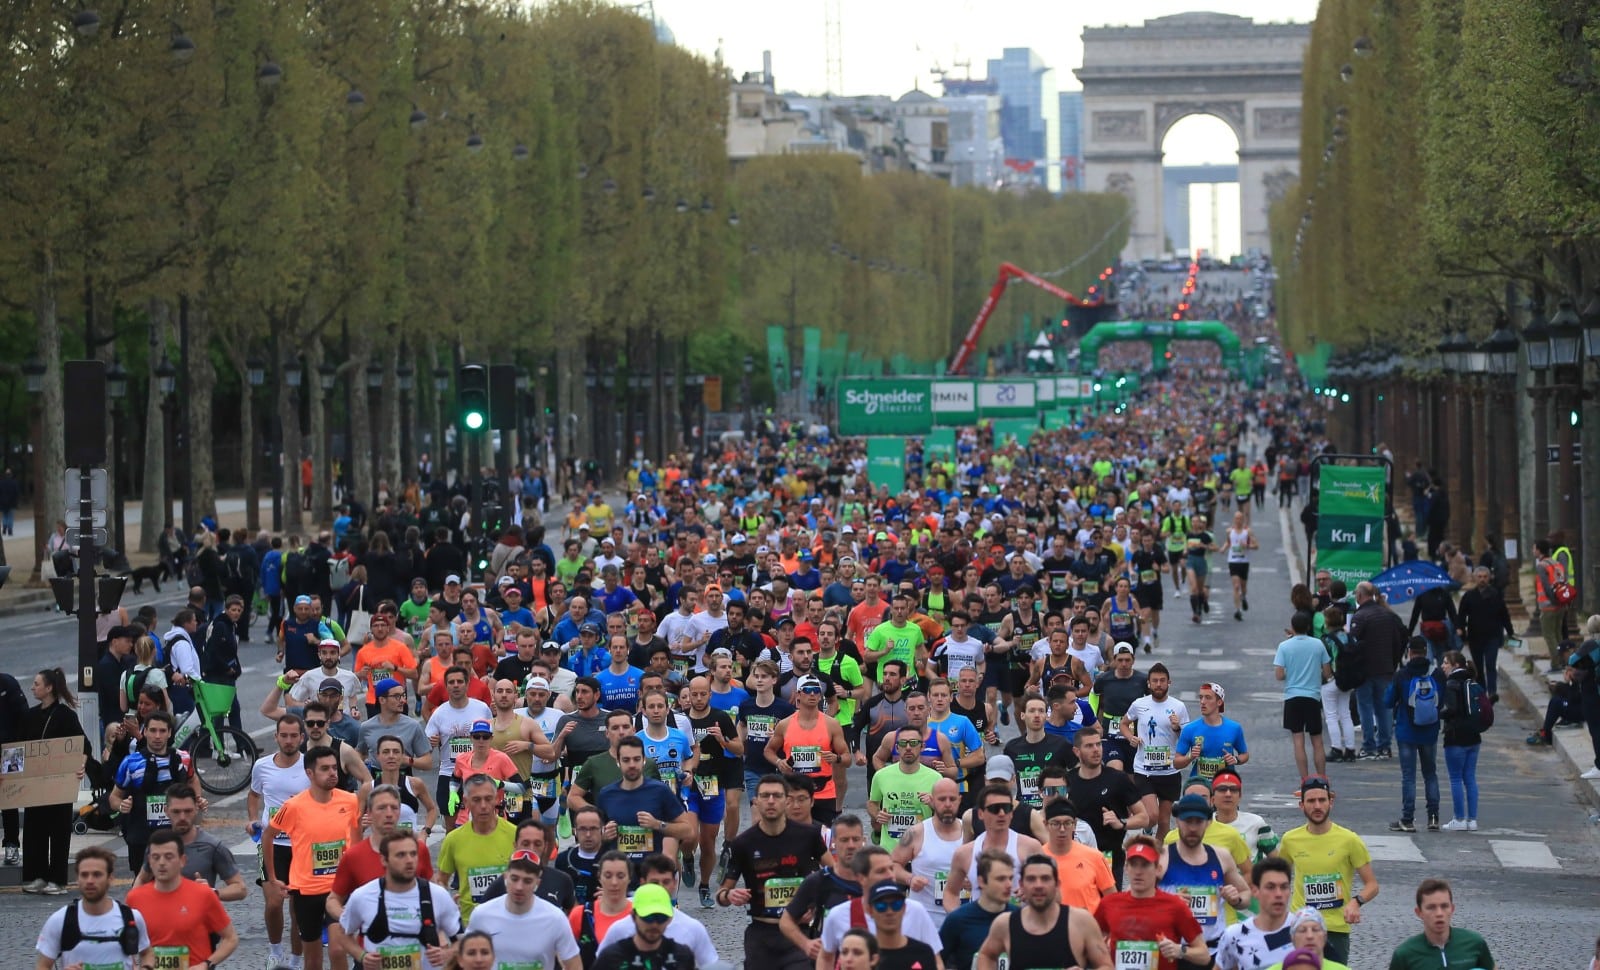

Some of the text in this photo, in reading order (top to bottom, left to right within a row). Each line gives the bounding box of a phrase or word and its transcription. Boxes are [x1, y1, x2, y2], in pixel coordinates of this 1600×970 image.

[846, 388, 924, 415] Schneider
[879, 404, 923, 412] Electric
[1331, 523, 1371, 543] Km 1
[793, 752, 815, 762] 15300
[151, 803, 166, 813] 137
[891, 815, 915, 826] 14062
[618, 834, 646, 845] 26844
[316, 849, 339, 862] 6988
[768, 886, 796, 900] 13752
[1306, 882, 1335, 896] 15086
[1120, 951, 1148, 964] 12371
